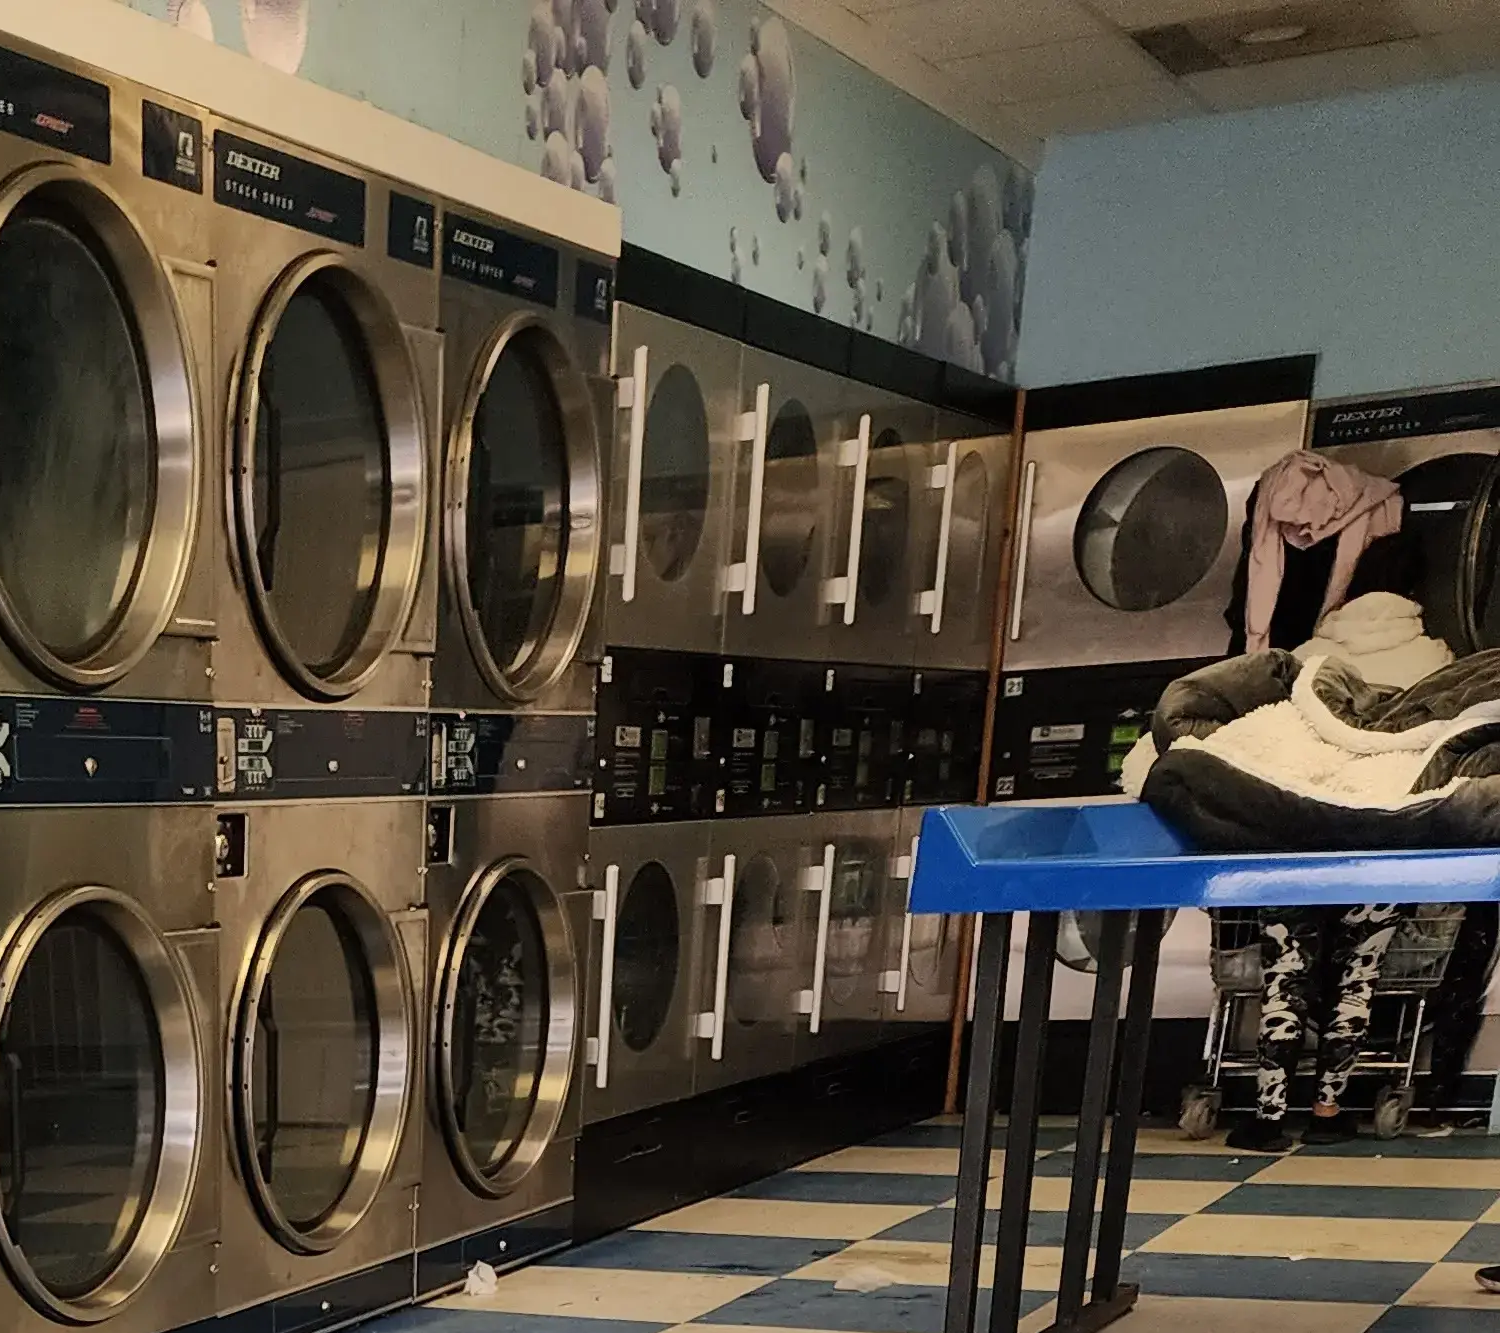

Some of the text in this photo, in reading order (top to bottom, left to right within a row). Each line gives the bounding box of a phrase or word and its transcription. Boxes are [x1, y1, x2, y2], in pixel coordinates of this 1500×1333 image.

[225, 150, 281, 181] DEXTER
[224, 179, 258, 200] STACK
[452, 229, 495, 254] DEXTER
[1332, 406, 1404, 424] DEXTER
[1007, 680, 1022, 693] 21
[997, 780, 1013, 792] 22
